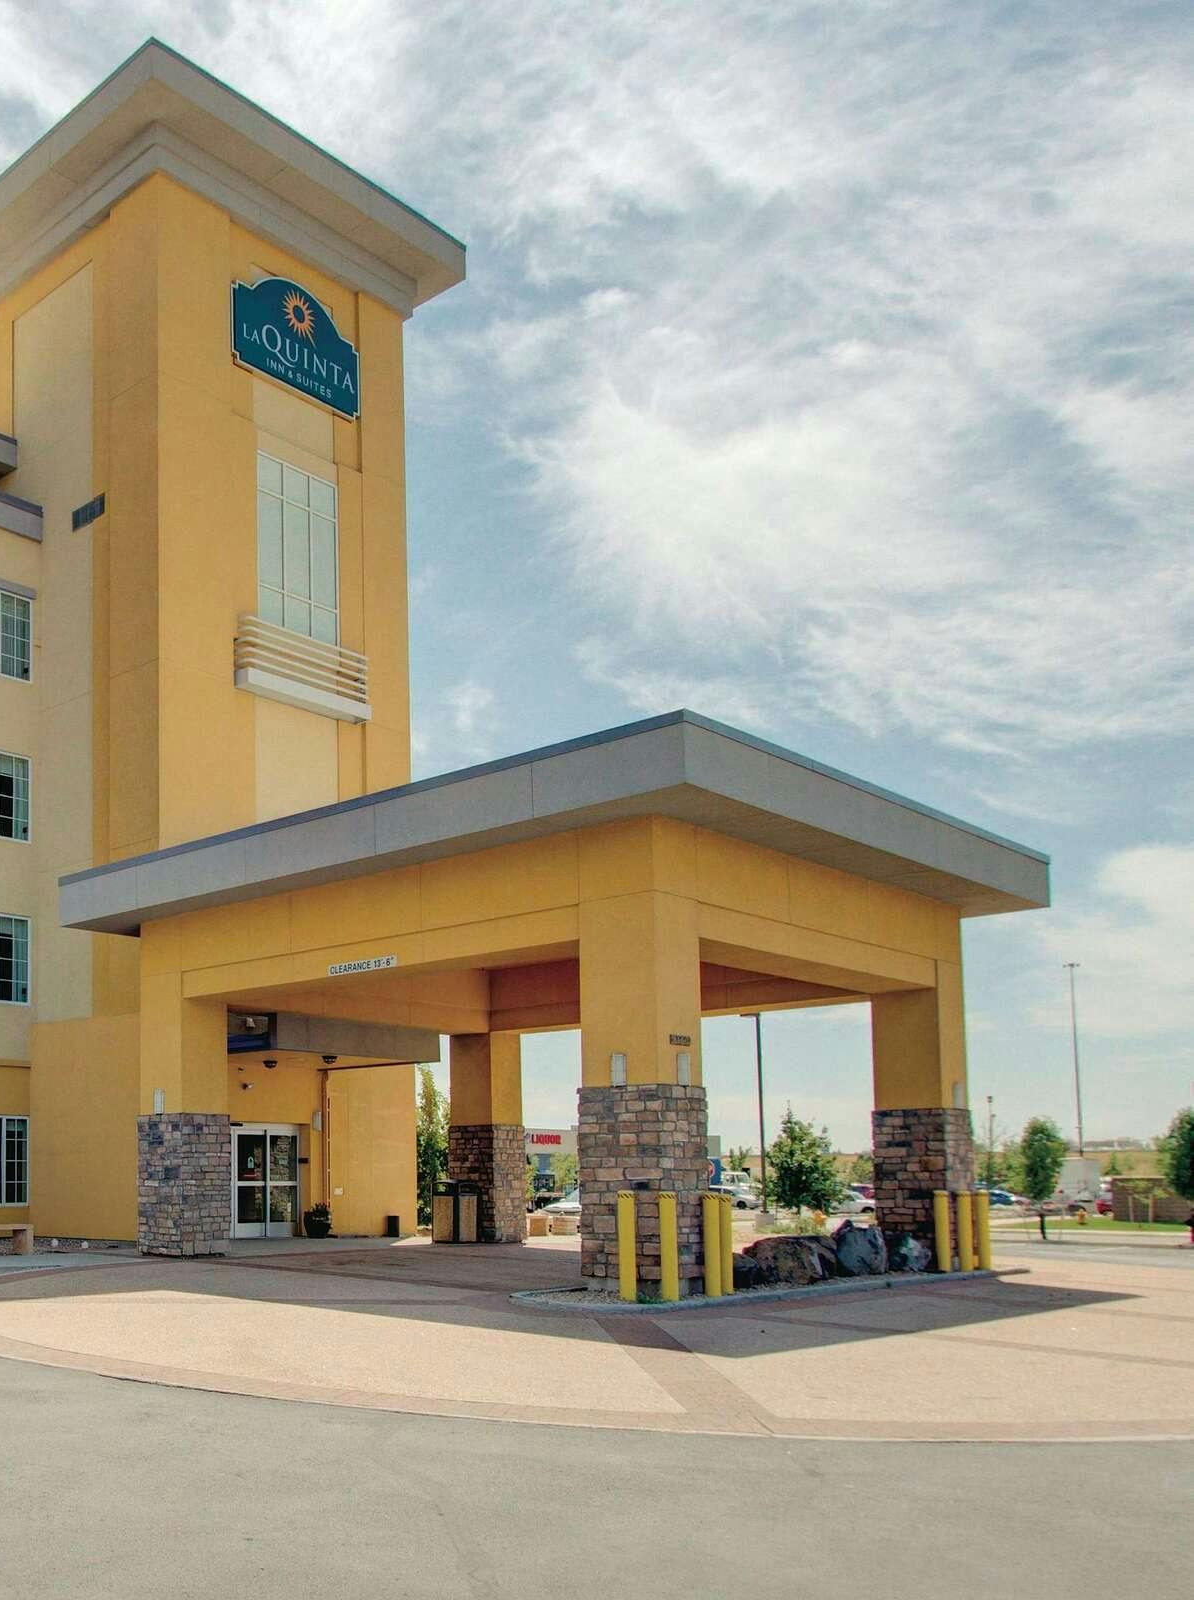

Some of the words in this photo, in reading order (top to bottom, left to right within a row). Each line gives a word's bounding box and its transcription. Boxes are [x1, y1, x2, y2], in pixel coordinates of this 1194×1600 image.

[243, 322, 261, 345] LA
[261, 324, 355, 394] QUINTA
[266, 357, 285, 375] INN
[296, 372, 332, 399] SUITES
[329, 960, 372, 975] CLEARANCE
[531, 1133, 561, 1145] LIQUOR
